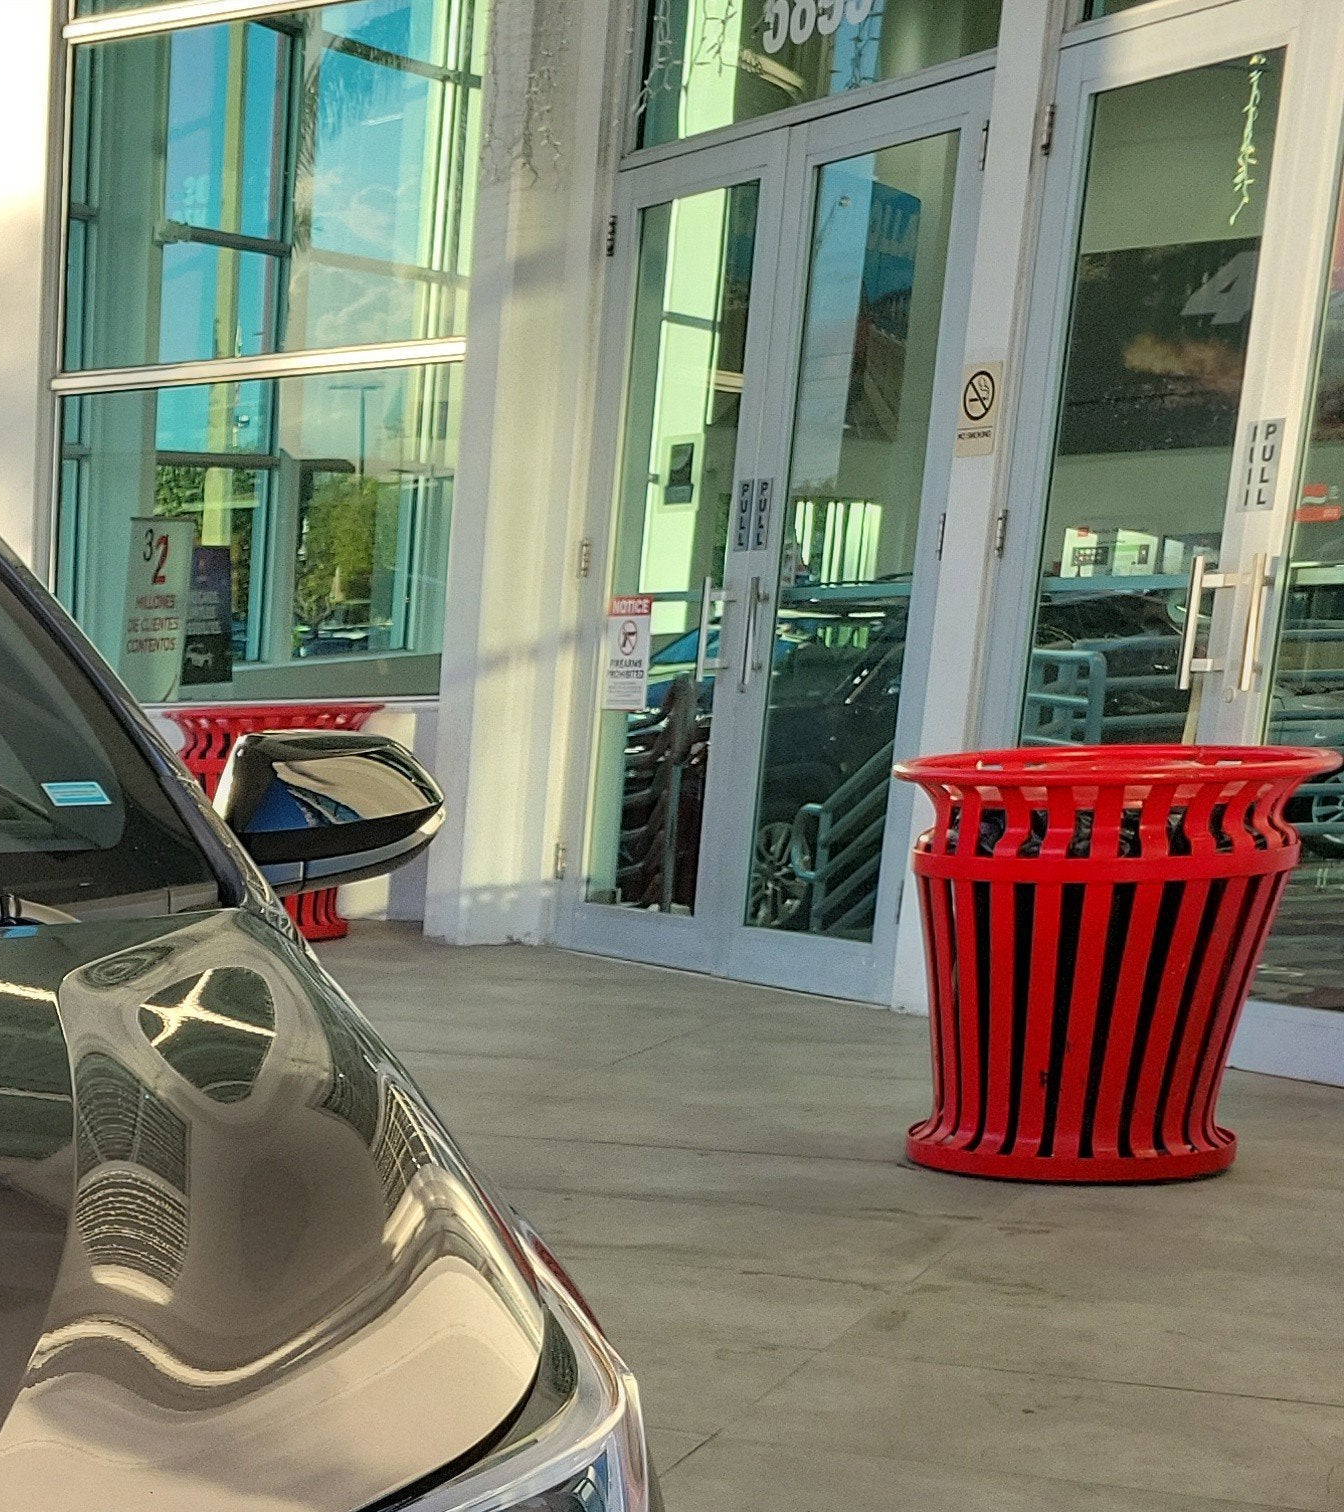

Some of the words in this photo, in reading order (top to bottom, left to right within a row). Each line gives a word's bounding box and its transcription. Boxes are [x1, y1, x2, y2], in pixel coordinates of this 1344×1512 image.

[1256, 423, 1277, 505] PULL
[738, 483, 750, 546] PULL
[757, 482, 768, 546] PULL
[612, 599, 650, 614] NOTICE
[127, 618, 141, 633] DE
[141, 616, 180, 631] CLIENTES
[126, 637, 176, 654] CONTENTOS
[610, 659, 643, 668] FIREARMS
[607, 670, 645, 679] PROHIBITED
